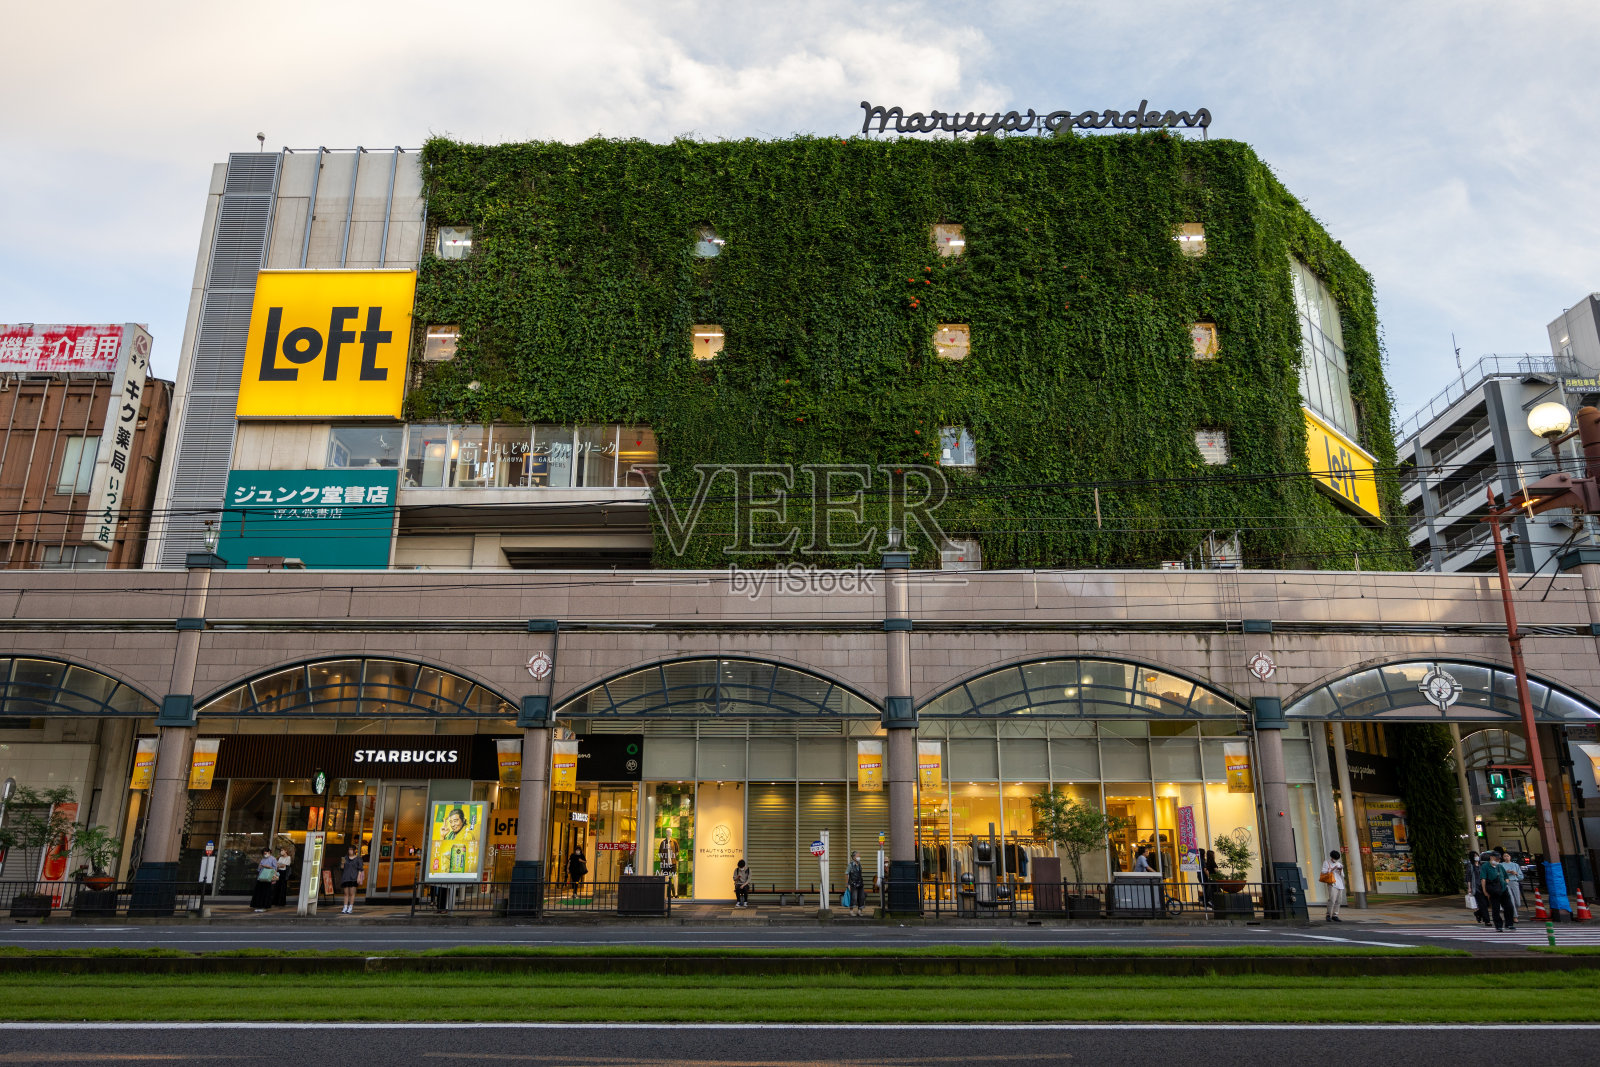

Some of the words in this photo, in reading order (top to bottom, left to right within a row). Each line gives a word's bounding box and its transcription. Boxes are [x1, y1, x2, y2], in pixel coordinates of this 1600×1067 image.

[1044, 99, 1213, 134] gardens
[234, 486, 390, 504] ジュンク堂書店
[354, 750, 458, 763] STARBUCKS
